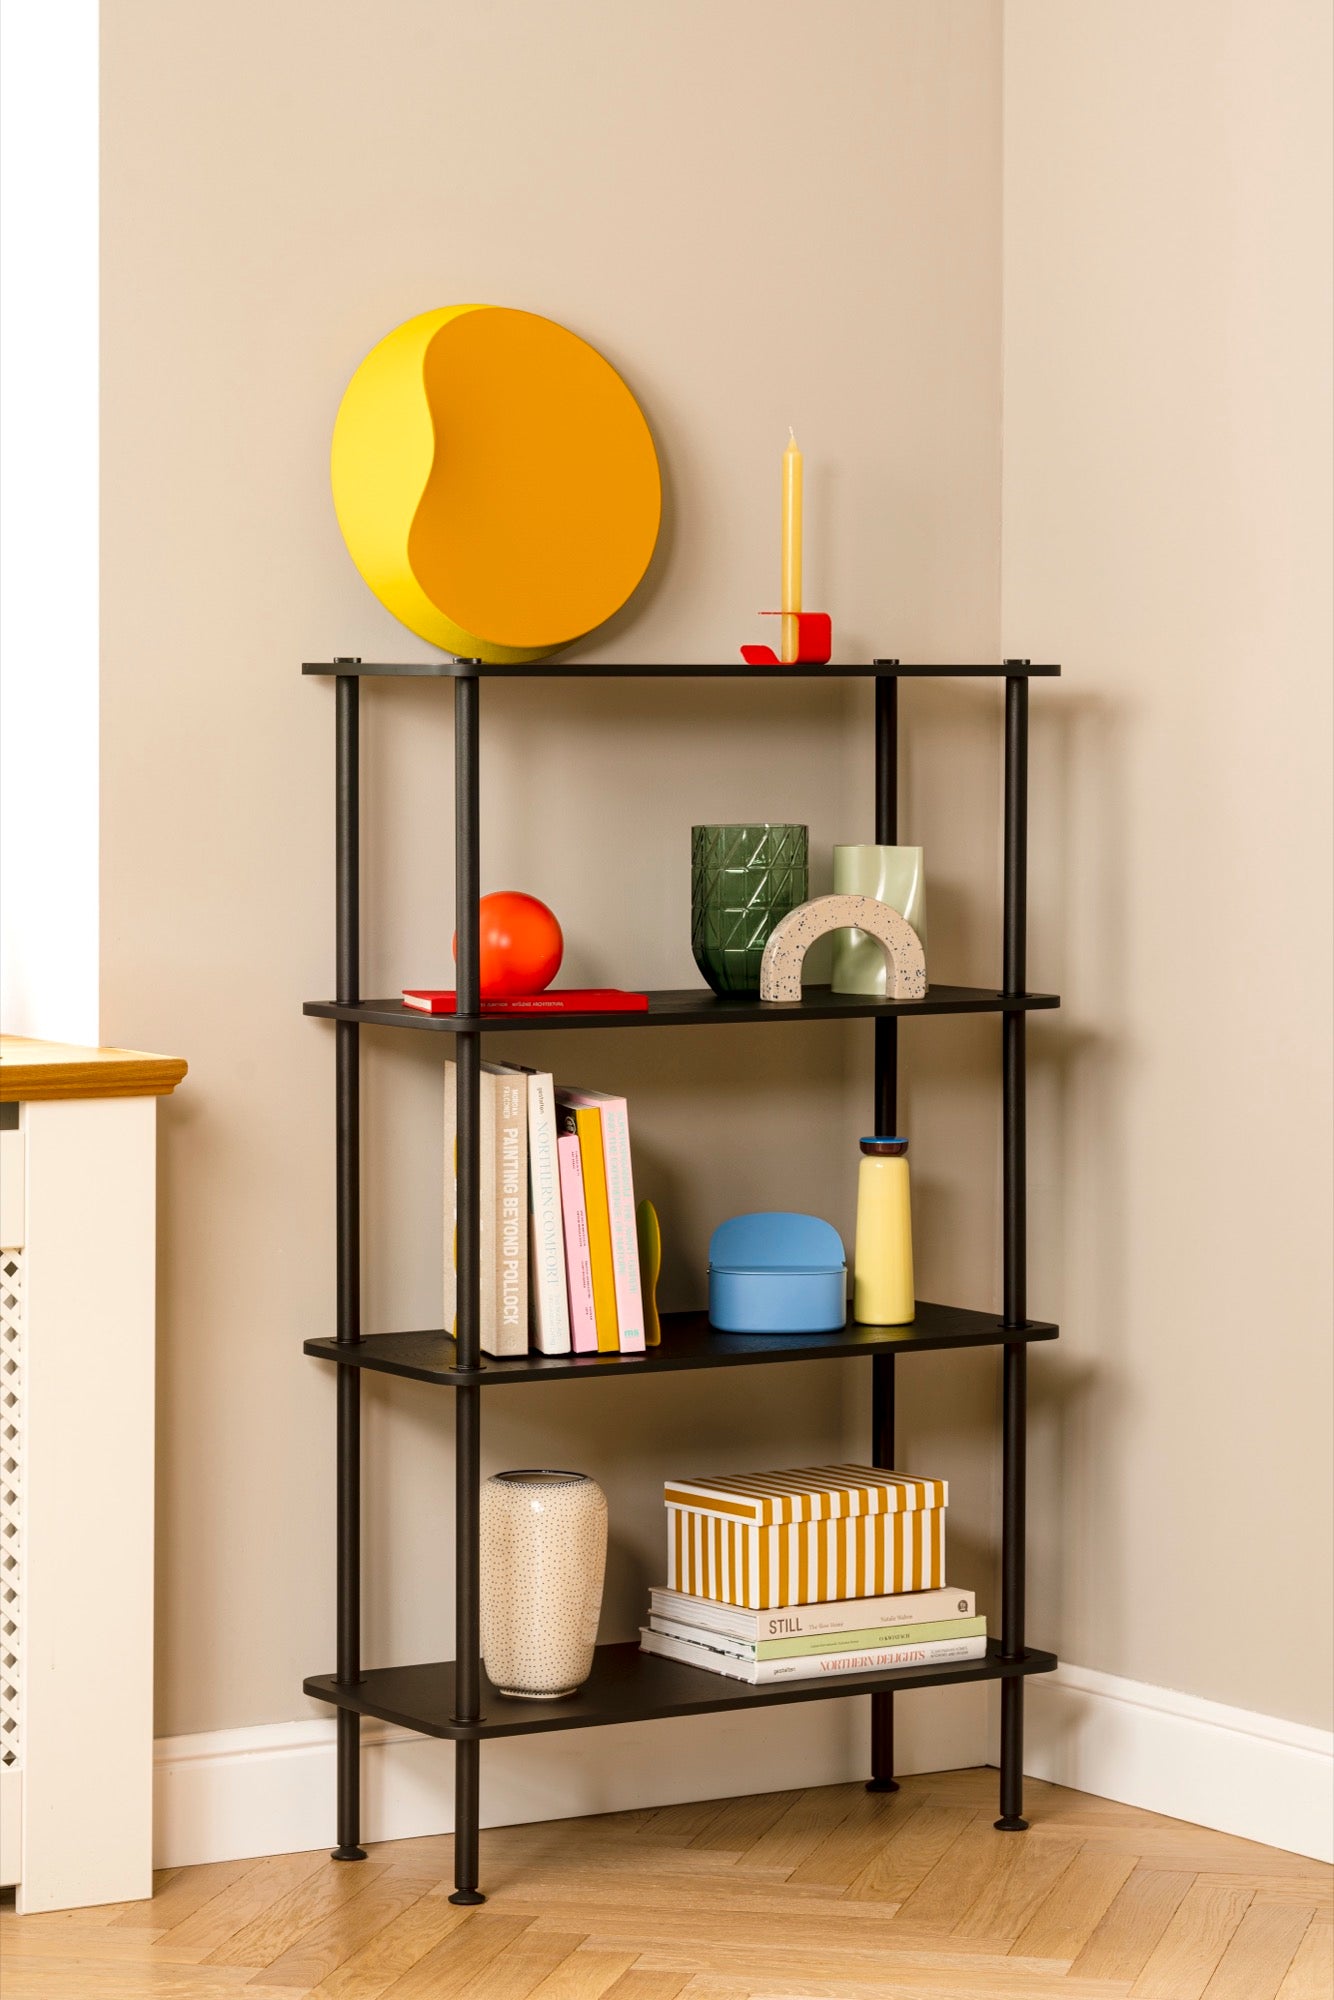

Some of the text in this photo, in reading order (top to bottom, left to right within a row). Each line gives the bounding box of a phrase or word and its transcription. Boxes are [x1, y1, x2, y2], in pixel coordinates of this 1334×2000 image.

[503, 1086, 511, 1118] FALCONER
[536, 1121, 554, 1207] NORTHERN
[503, 1128, 519, 1325] PAINTING BEYOND POLLOCK
[542, 1210, 559, 1284] COMFORT
[768, 1617, 803, 1634] STILL
[819, 1655, 875, 1672] NORTHERN
[876, 1650, 926, 1666] DELIGHTS
